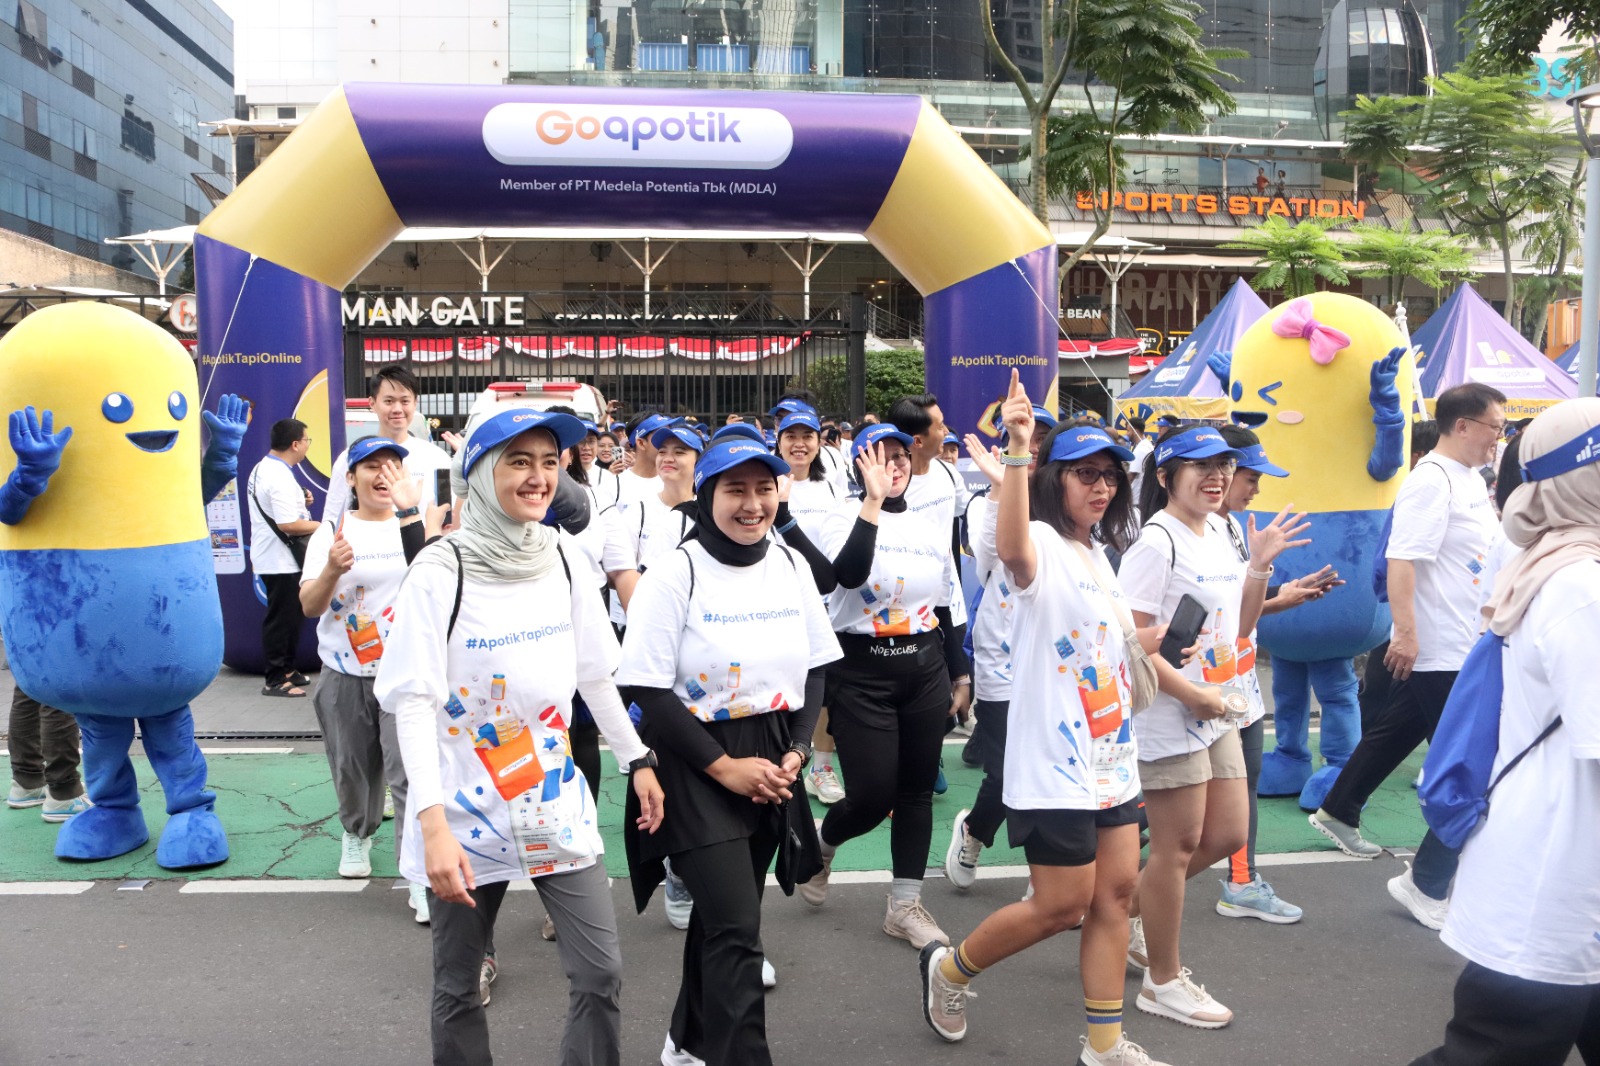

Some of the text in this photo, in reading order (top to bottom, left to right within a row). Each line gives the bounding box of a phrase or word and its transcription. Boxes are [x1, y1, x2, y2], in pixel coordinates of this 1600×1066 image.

[535, 109, 742, 151] Goapotik
[500, 178, 777, 196] Member of PT Medela Potentia Tbk (MDLA)
[1076, 191, 1366, 220] SPORTS STATION
[341, 297, 419, 326] MAN
[431, 296, 525, 326] GATE
[1067, 309, 1102, 319] BEAN
[202, 352, 302, 366] #ApotikTapiOnline
[951, 355, 1048, 368] #ApotikTapiOnline
